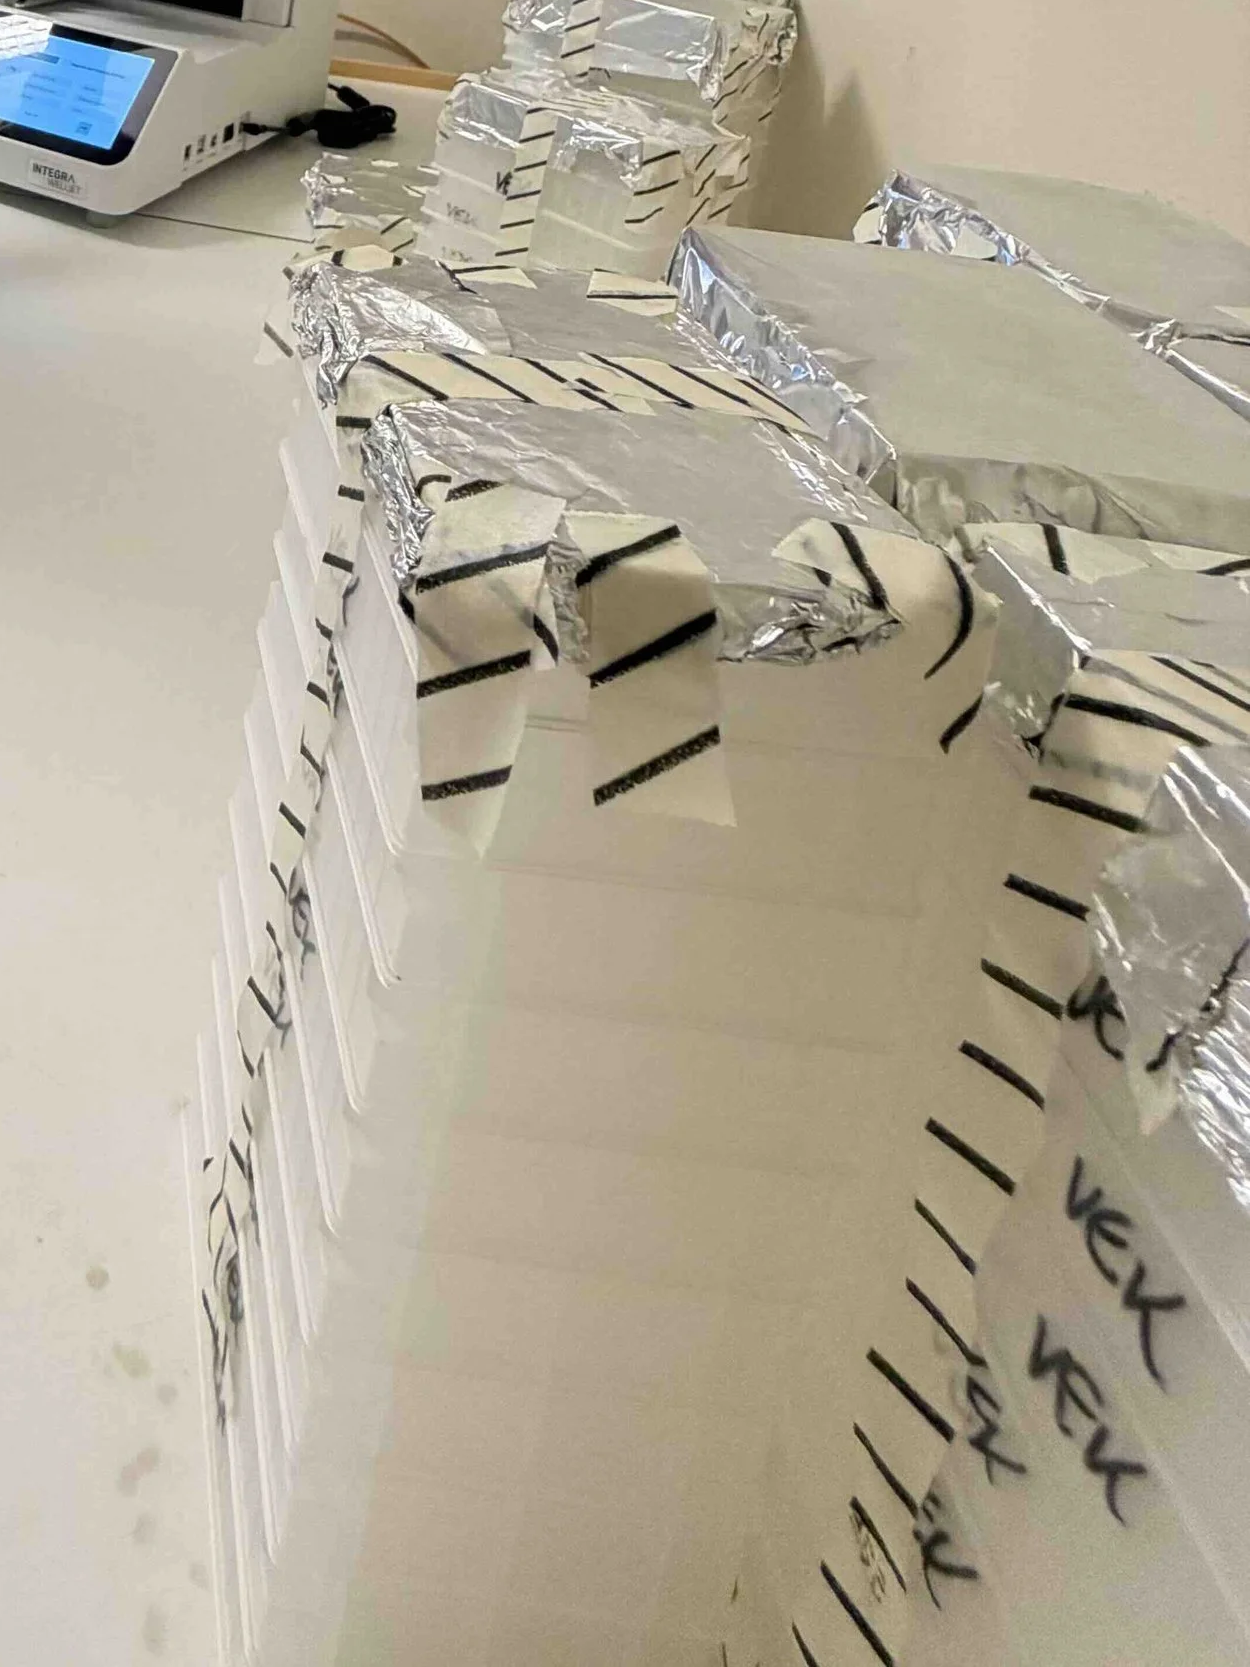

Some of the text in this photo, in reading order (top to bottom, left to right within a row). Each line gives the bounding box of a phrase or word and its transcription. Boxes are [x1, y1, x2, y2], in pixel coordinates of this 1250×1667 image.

[32, 162, 76, 184] INTEGRA
[1065, 1154, 1187, 1391] VEK
[1029, 1313, 1147, 1526] VEK
